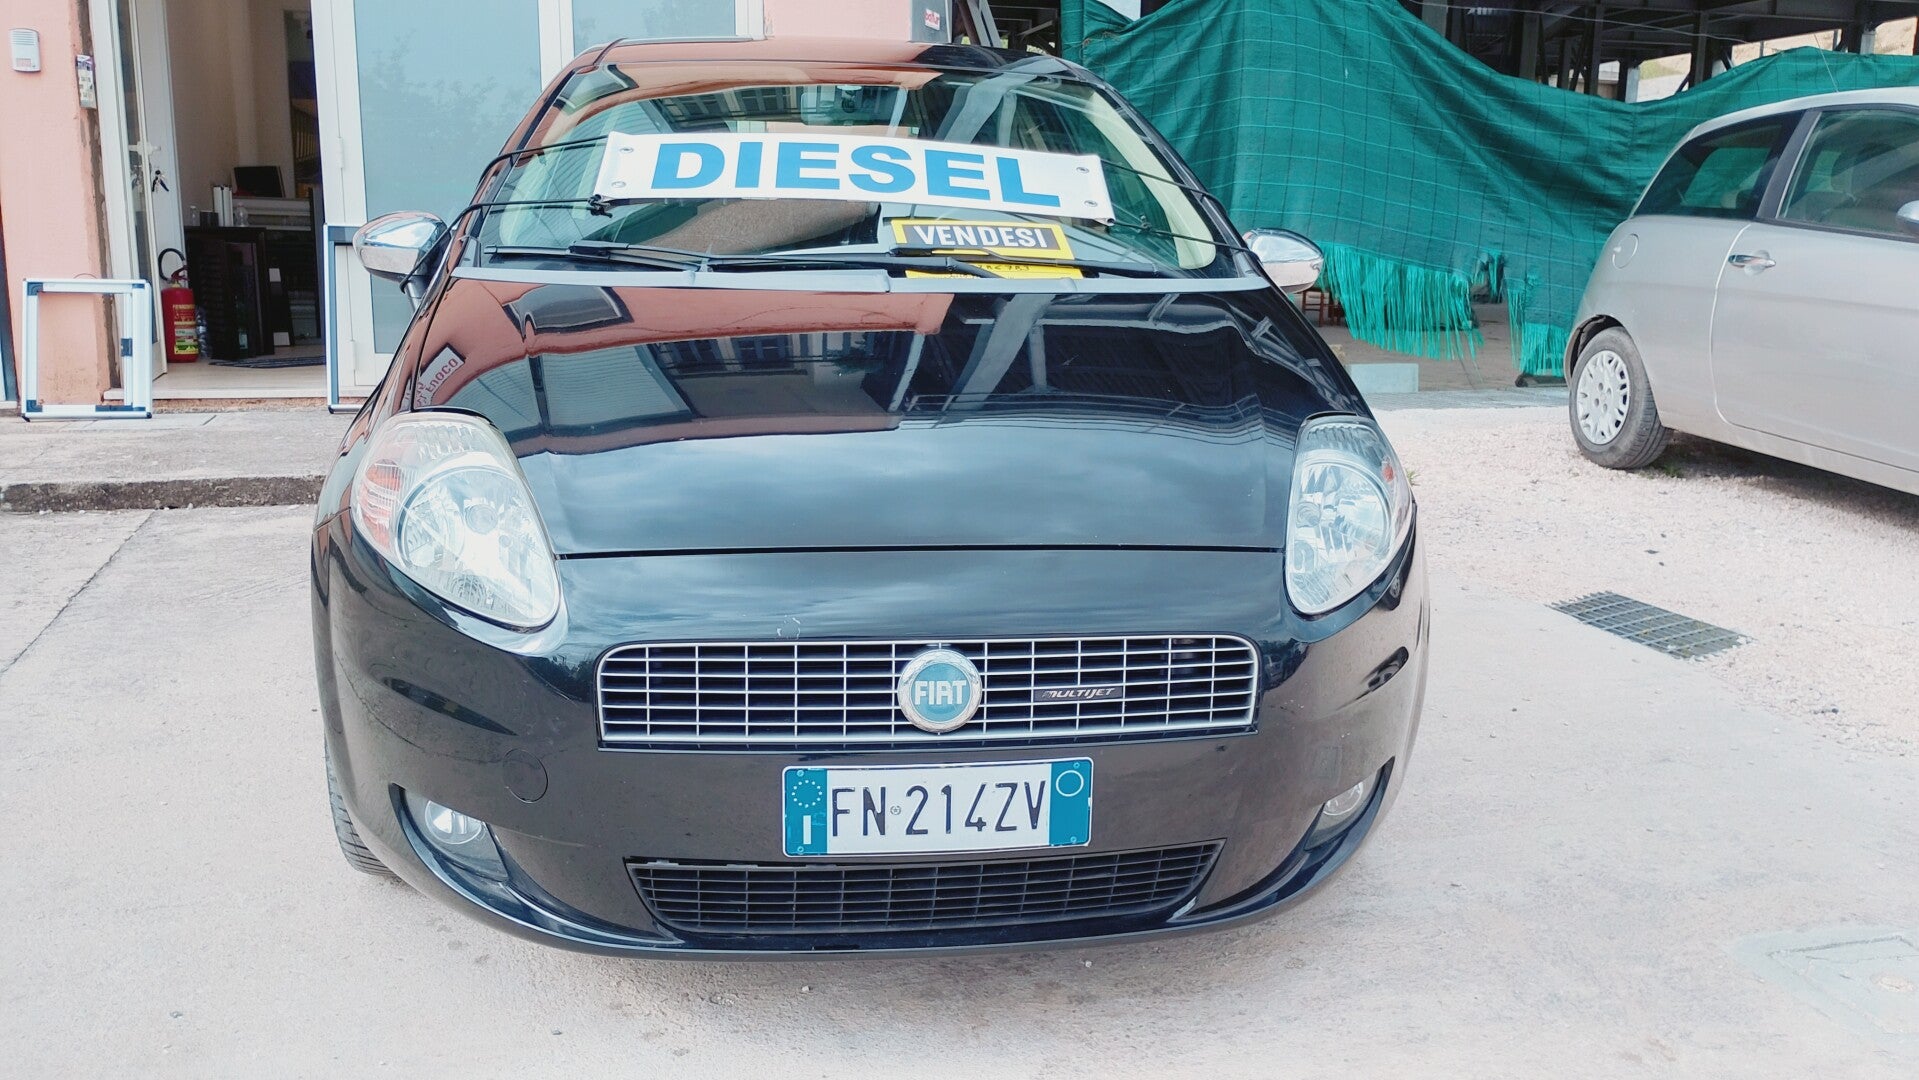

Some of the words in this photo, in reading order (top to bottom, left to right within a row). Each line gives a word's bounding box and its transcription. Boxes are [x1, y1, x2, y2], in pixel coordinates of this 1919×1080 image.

[651, 142, 1061, 208] DIESEL
[913, 225, 1048, 248] VENDESI
[914, 680, 967, 705] FIAT
[1041, 687, 1116, 699] MULTIJET
[832, 786, 886, 836] FN
[905, 780, 1046, 835] 214ZV
